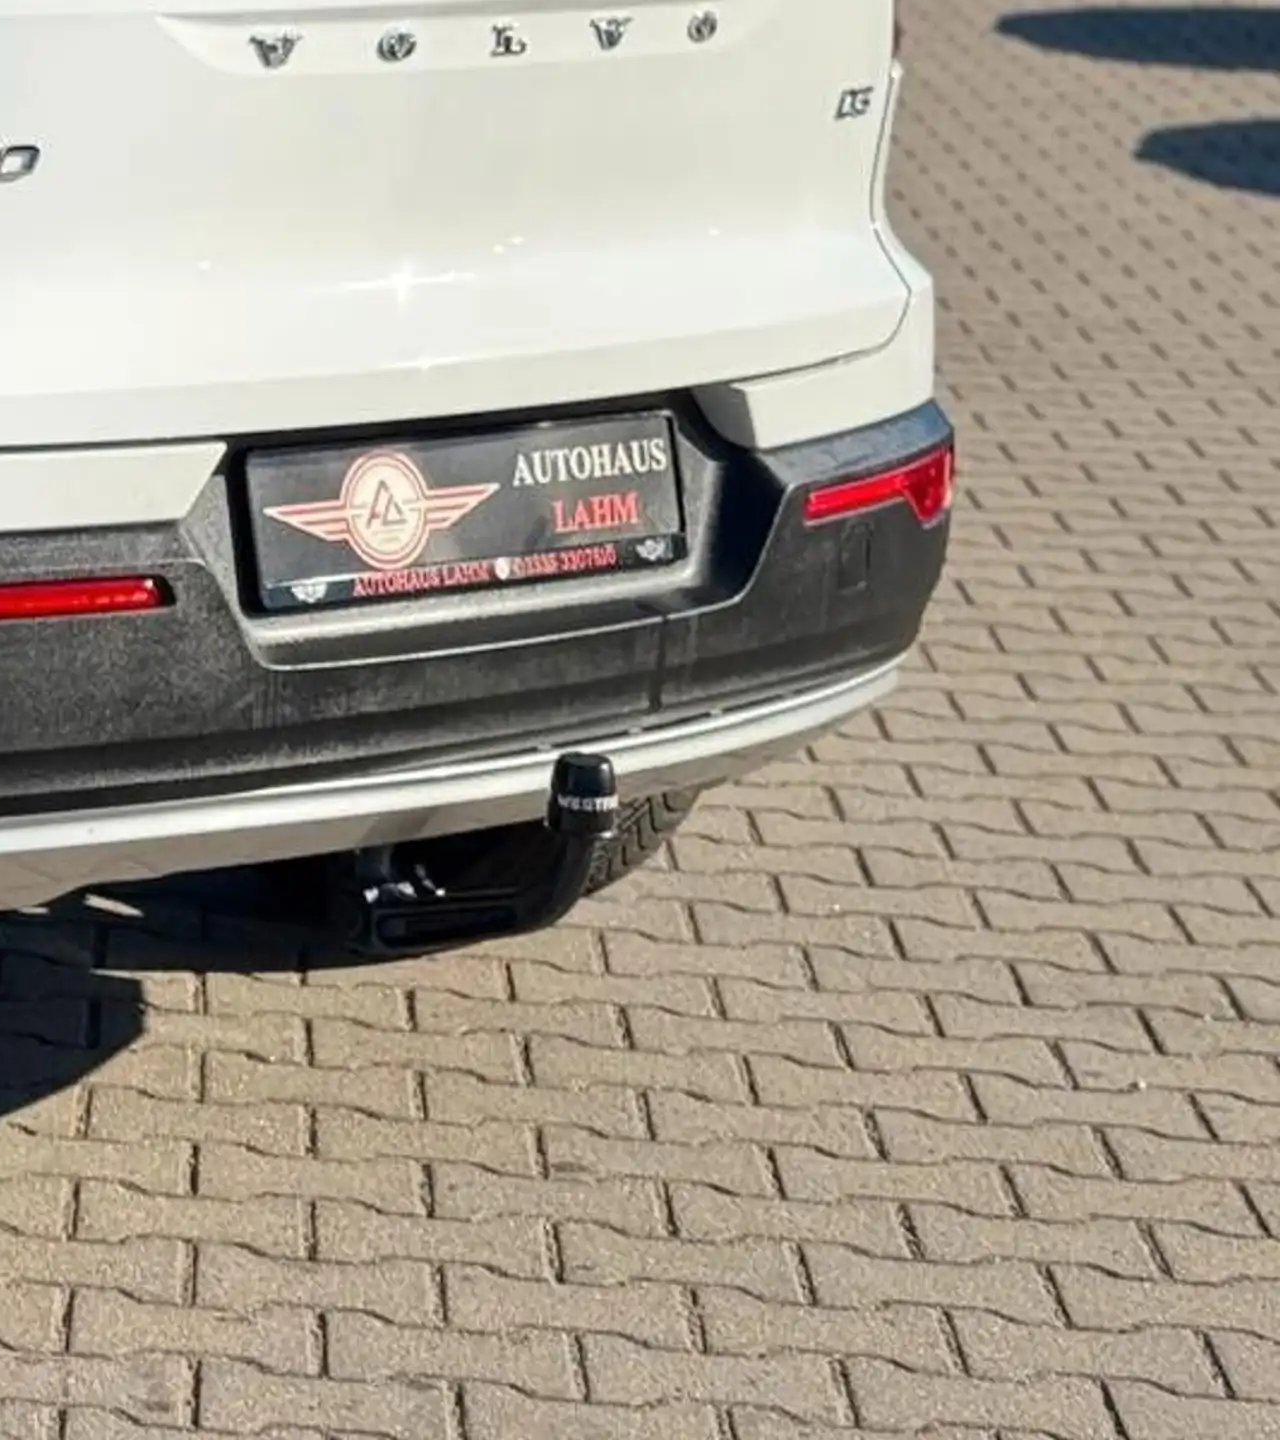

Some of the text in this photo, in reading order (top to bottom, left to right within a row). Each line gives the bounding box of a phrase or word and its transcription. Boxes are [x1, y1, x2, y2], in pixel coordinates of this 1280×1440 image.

[248, 10, 718, 70] VOLVO
[512, 438, 668, 488] AUTOHAUS
[551, 491, 640, 534] LAHM
[352, 568, 440, 597] AUTOHAUS
